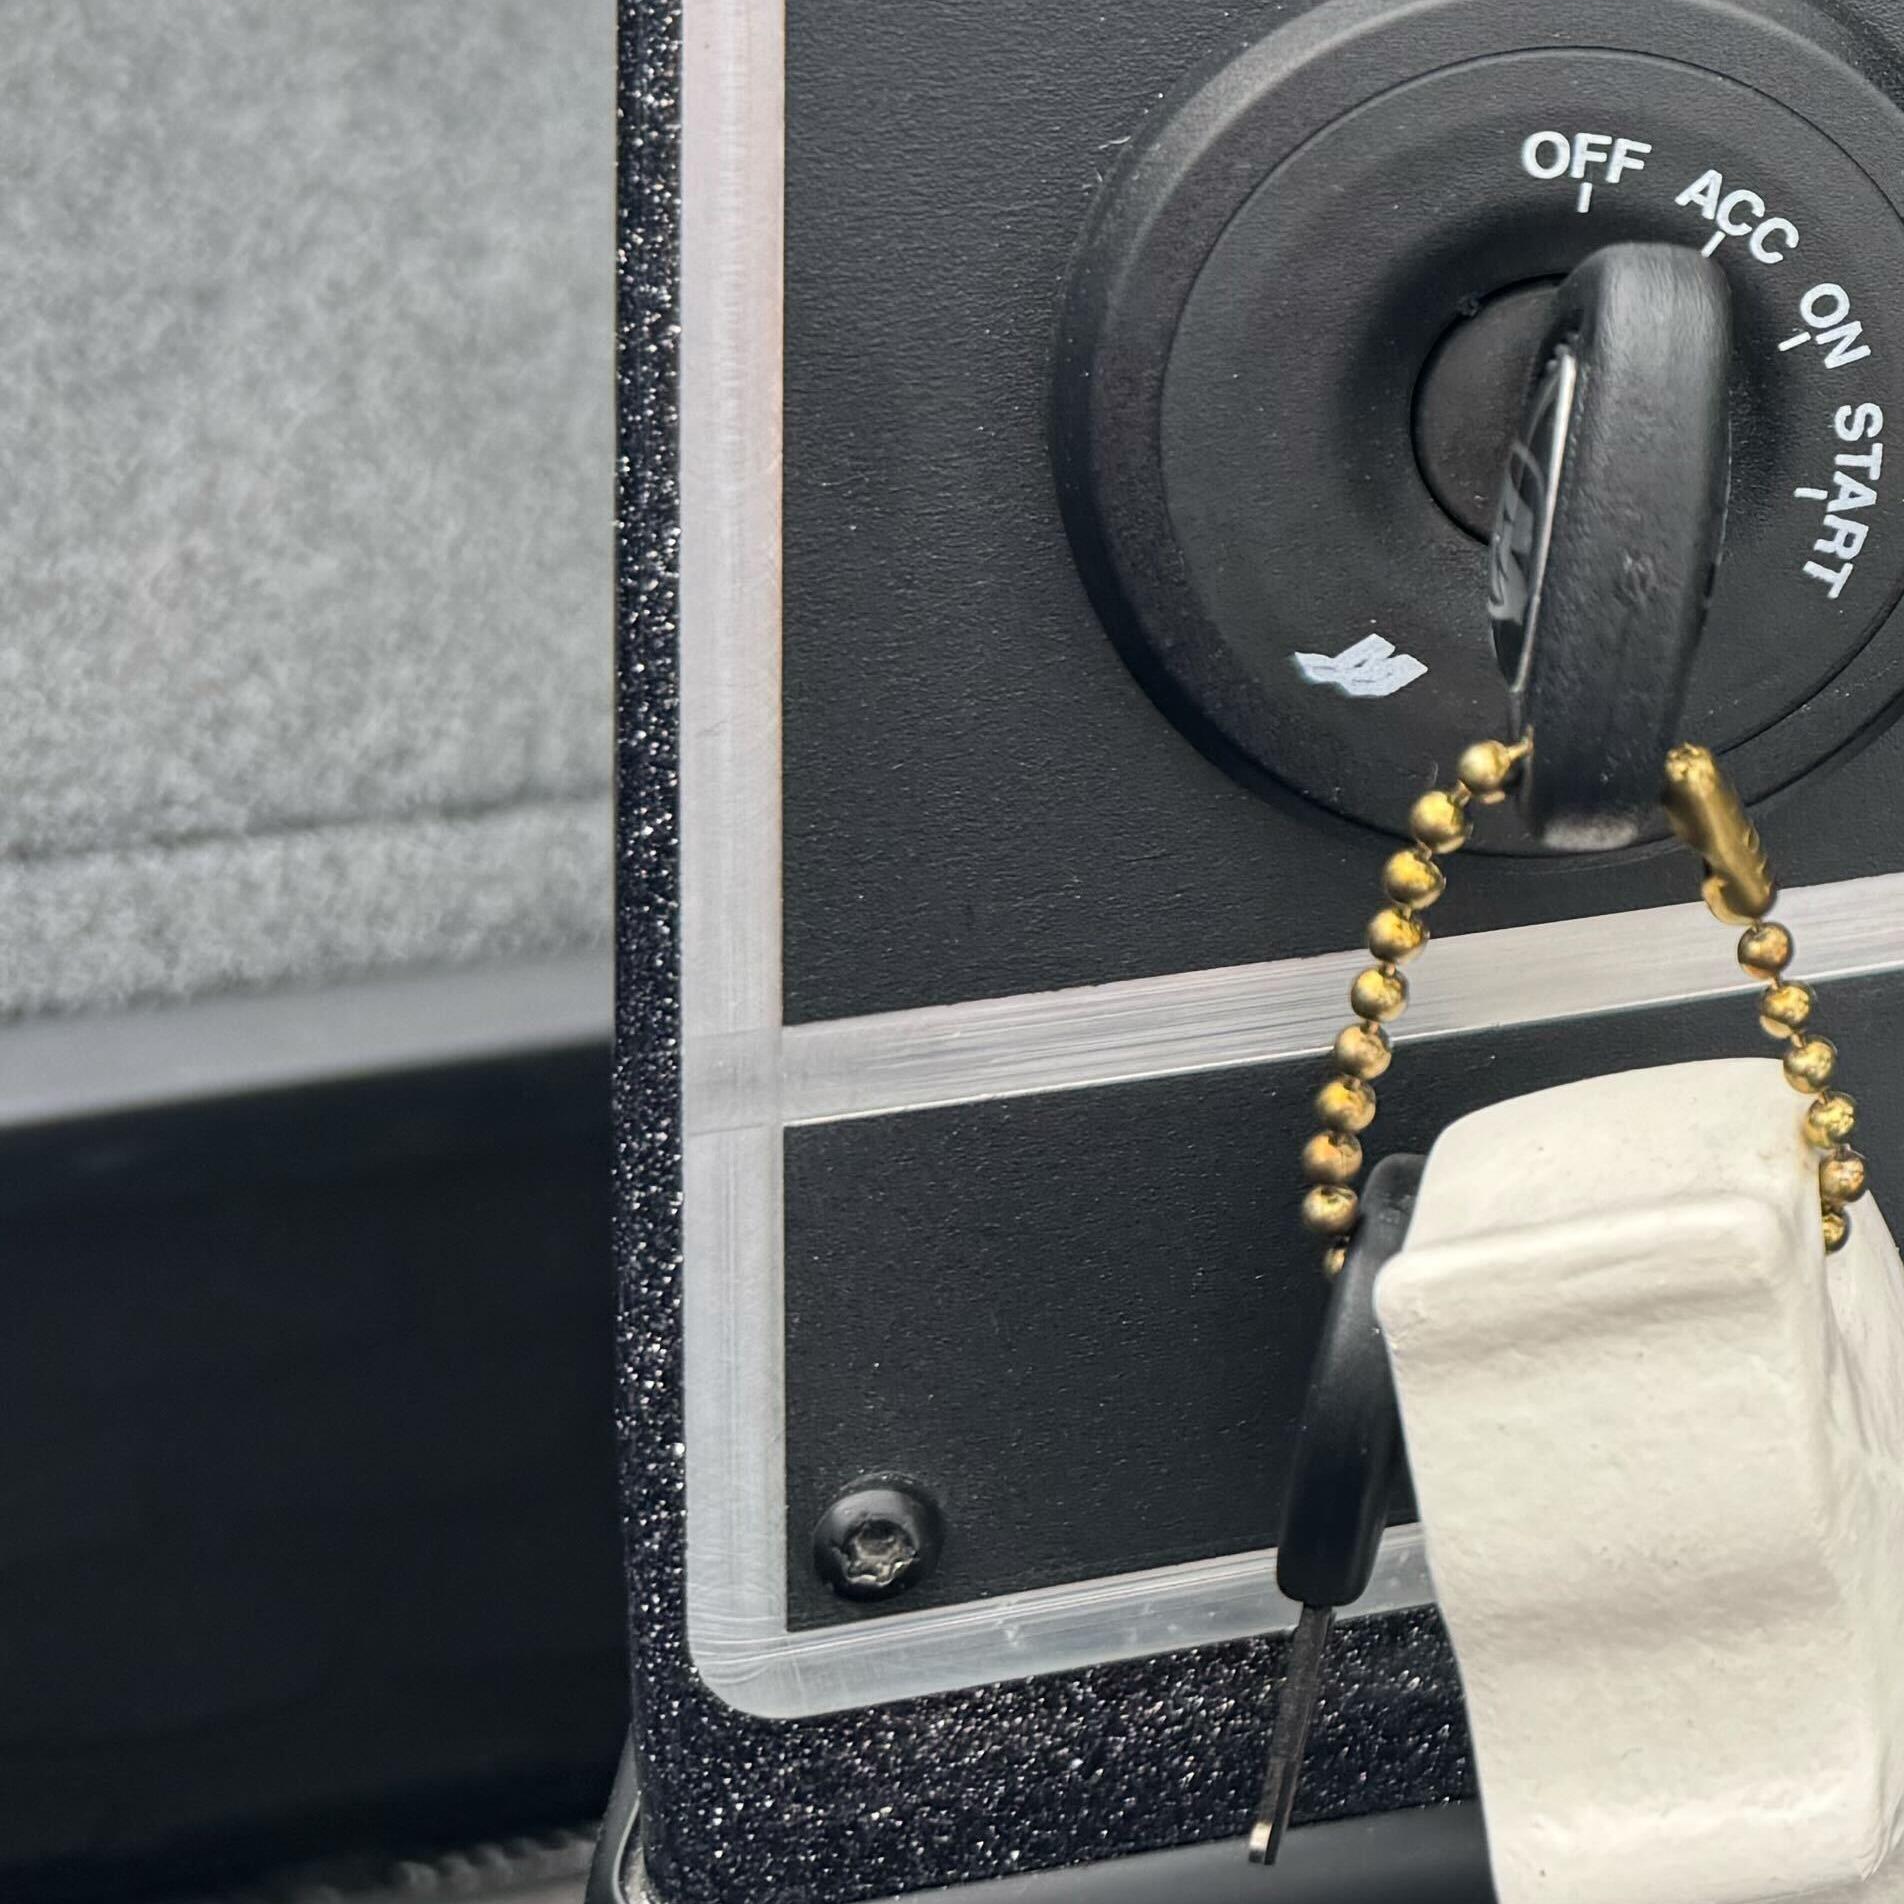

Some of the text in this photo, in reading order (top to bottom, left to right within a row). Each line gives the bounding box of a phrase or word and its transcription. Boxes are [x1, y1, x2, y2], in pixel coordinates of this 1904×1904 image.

[1521, 130, 1652, 184] OFF
[1674, 169, 1799, 264] ACC
[1800, 282, 1871, 369] ON
[1803, 402, 1884, 599] START
